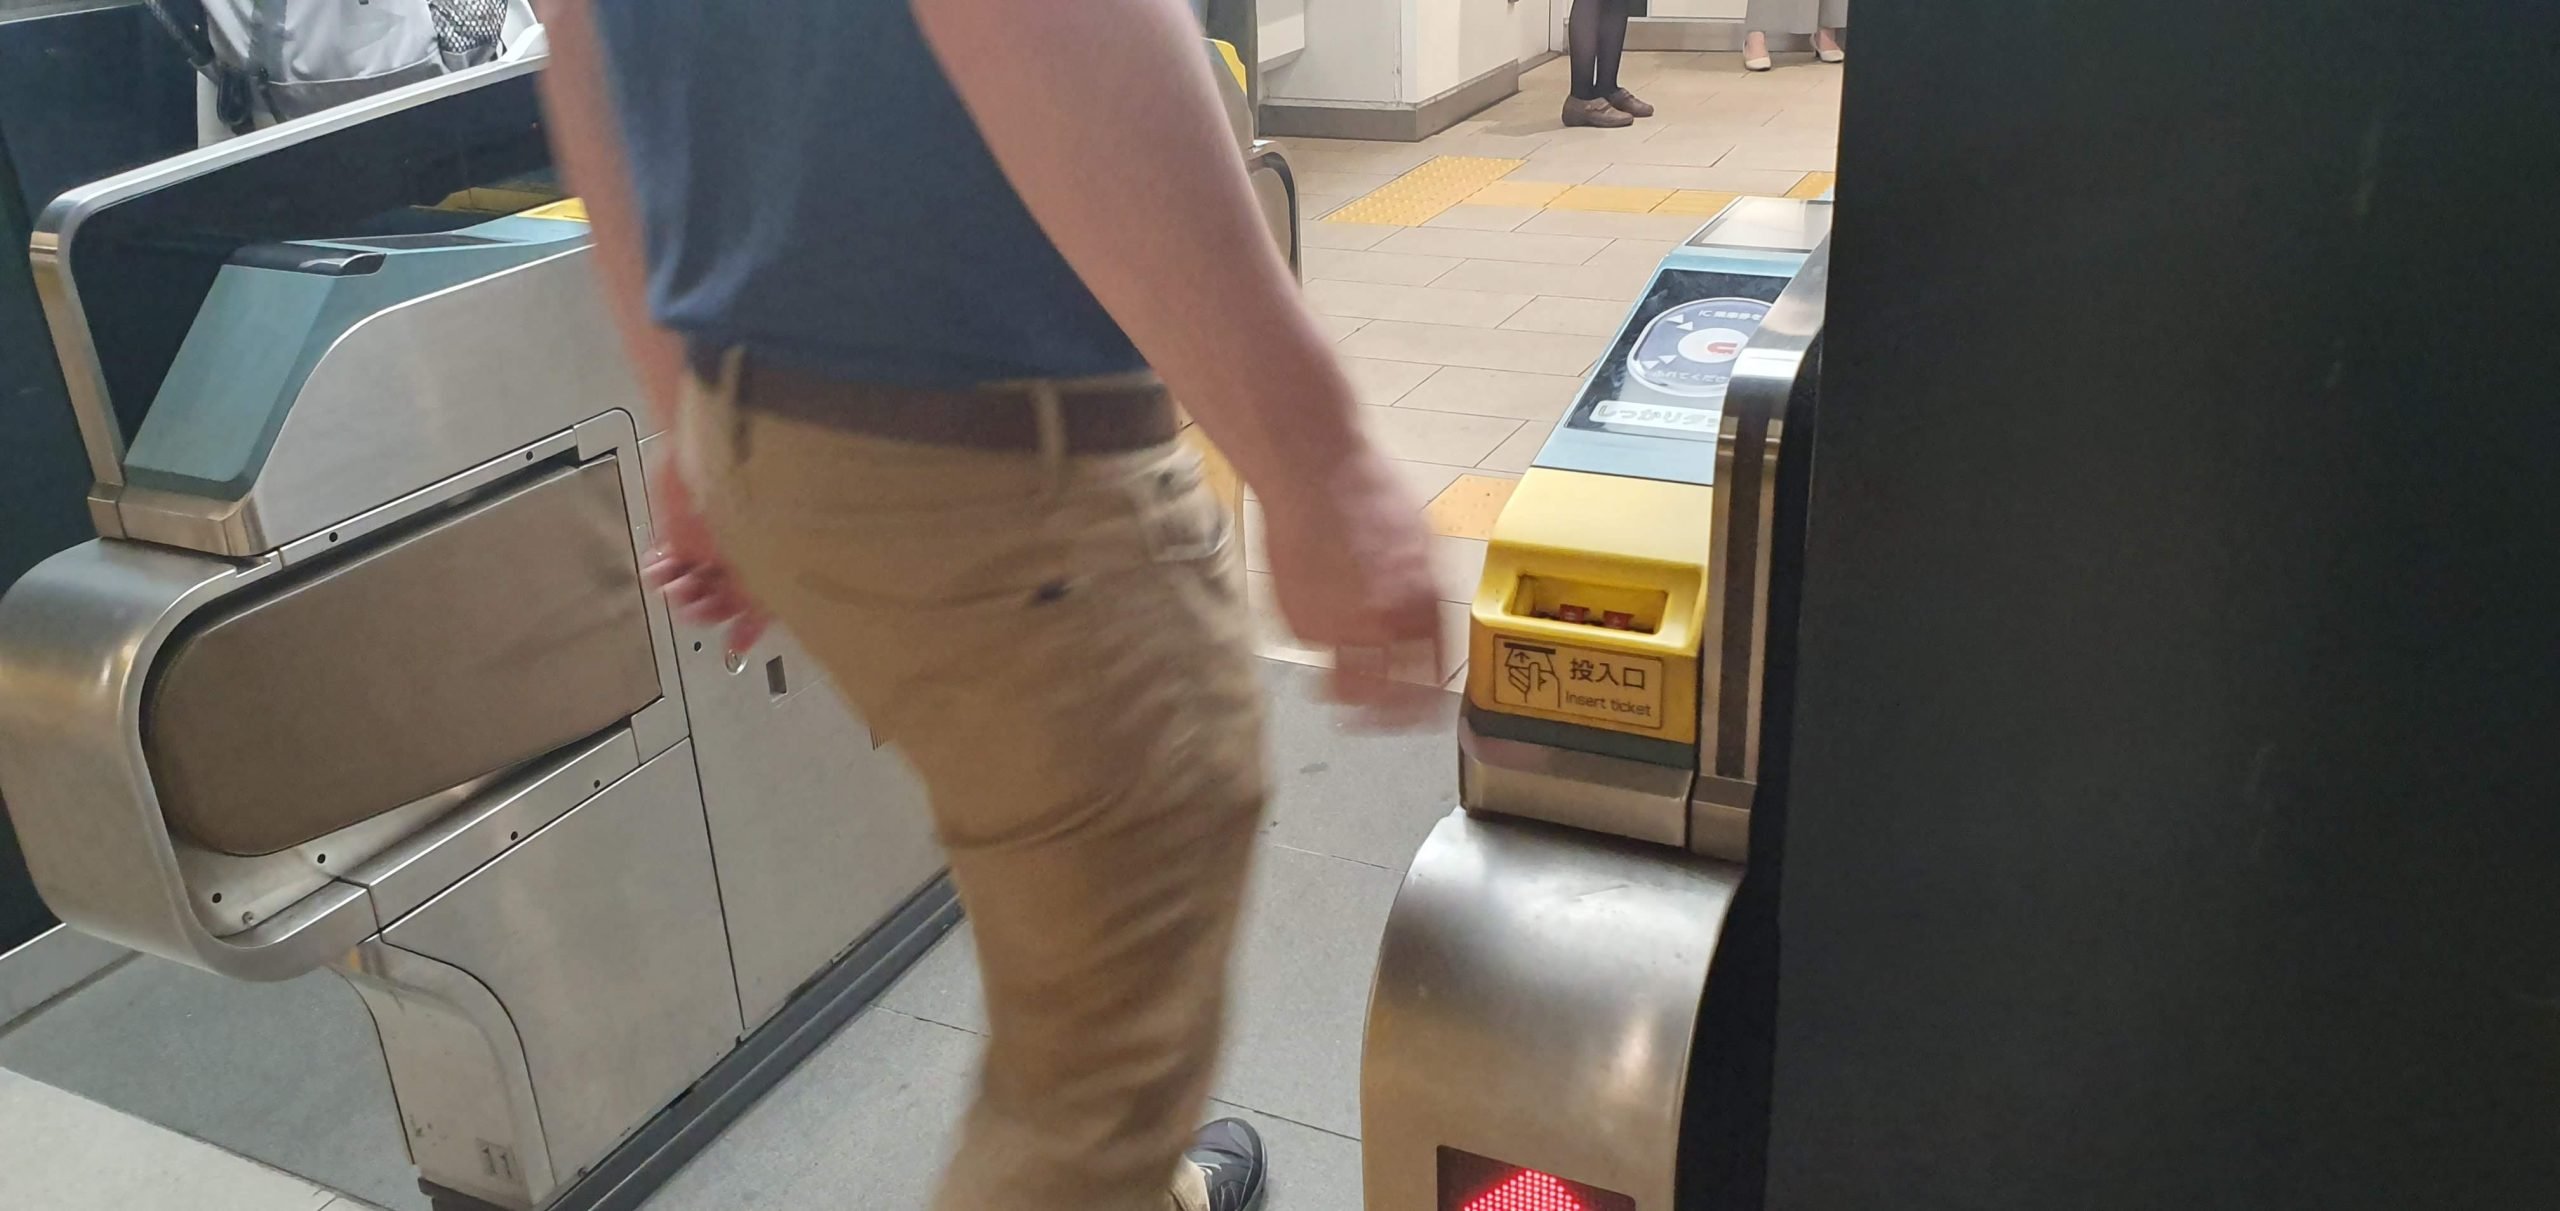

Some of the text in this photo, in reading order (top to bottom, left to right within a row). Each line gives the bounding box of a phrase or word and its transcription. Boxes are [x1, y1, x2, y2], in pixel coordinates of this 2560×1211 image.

[1569, 658, 1645, 690] 投入口
[1565, 690, 1652, 716] Insert ticket
[481, 1147, 512, 1179] 11
